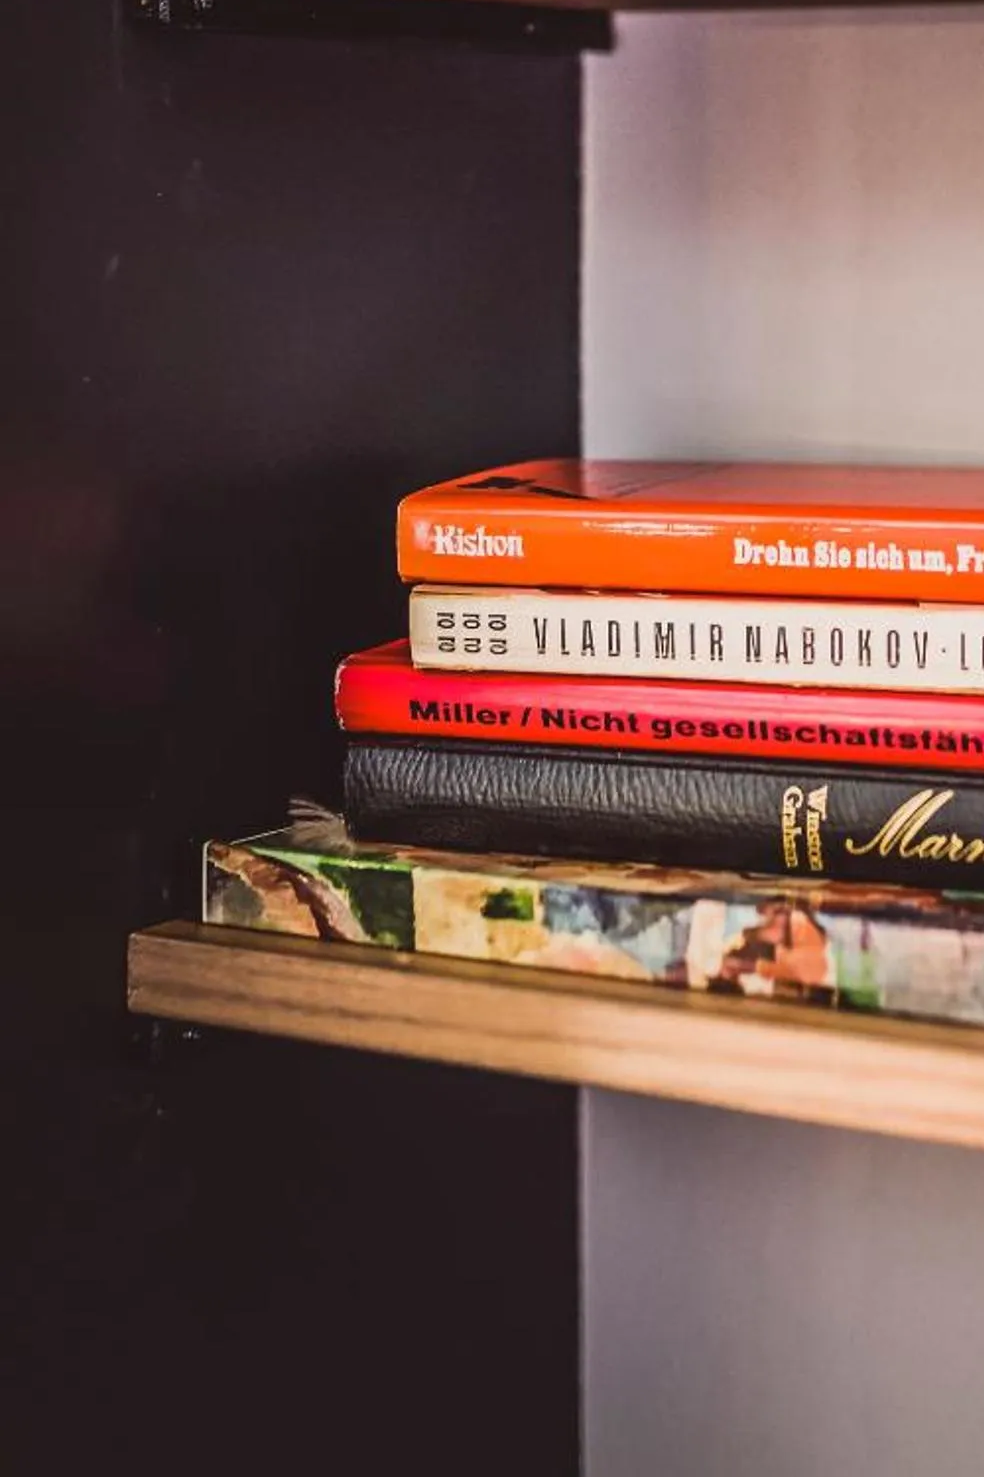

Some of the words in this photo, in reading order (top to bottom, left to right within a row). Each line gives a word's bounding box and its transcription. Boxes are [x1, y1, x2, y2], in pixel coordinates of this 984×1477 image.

[433, 524, 524, 557] Kishon
[734, 537, 810, 567] Drehn
[814, 540, 850, 569] Sie
[855, 542, 905, 571] sich
[908, 549, 953, 576] um,
[533, 618, 723, 660] VLADIMIR
[745, 625, 929, 667] NABOKOV
[409, 700, 512, 727] Miller
[541, 707, 640, 735] Nicht
